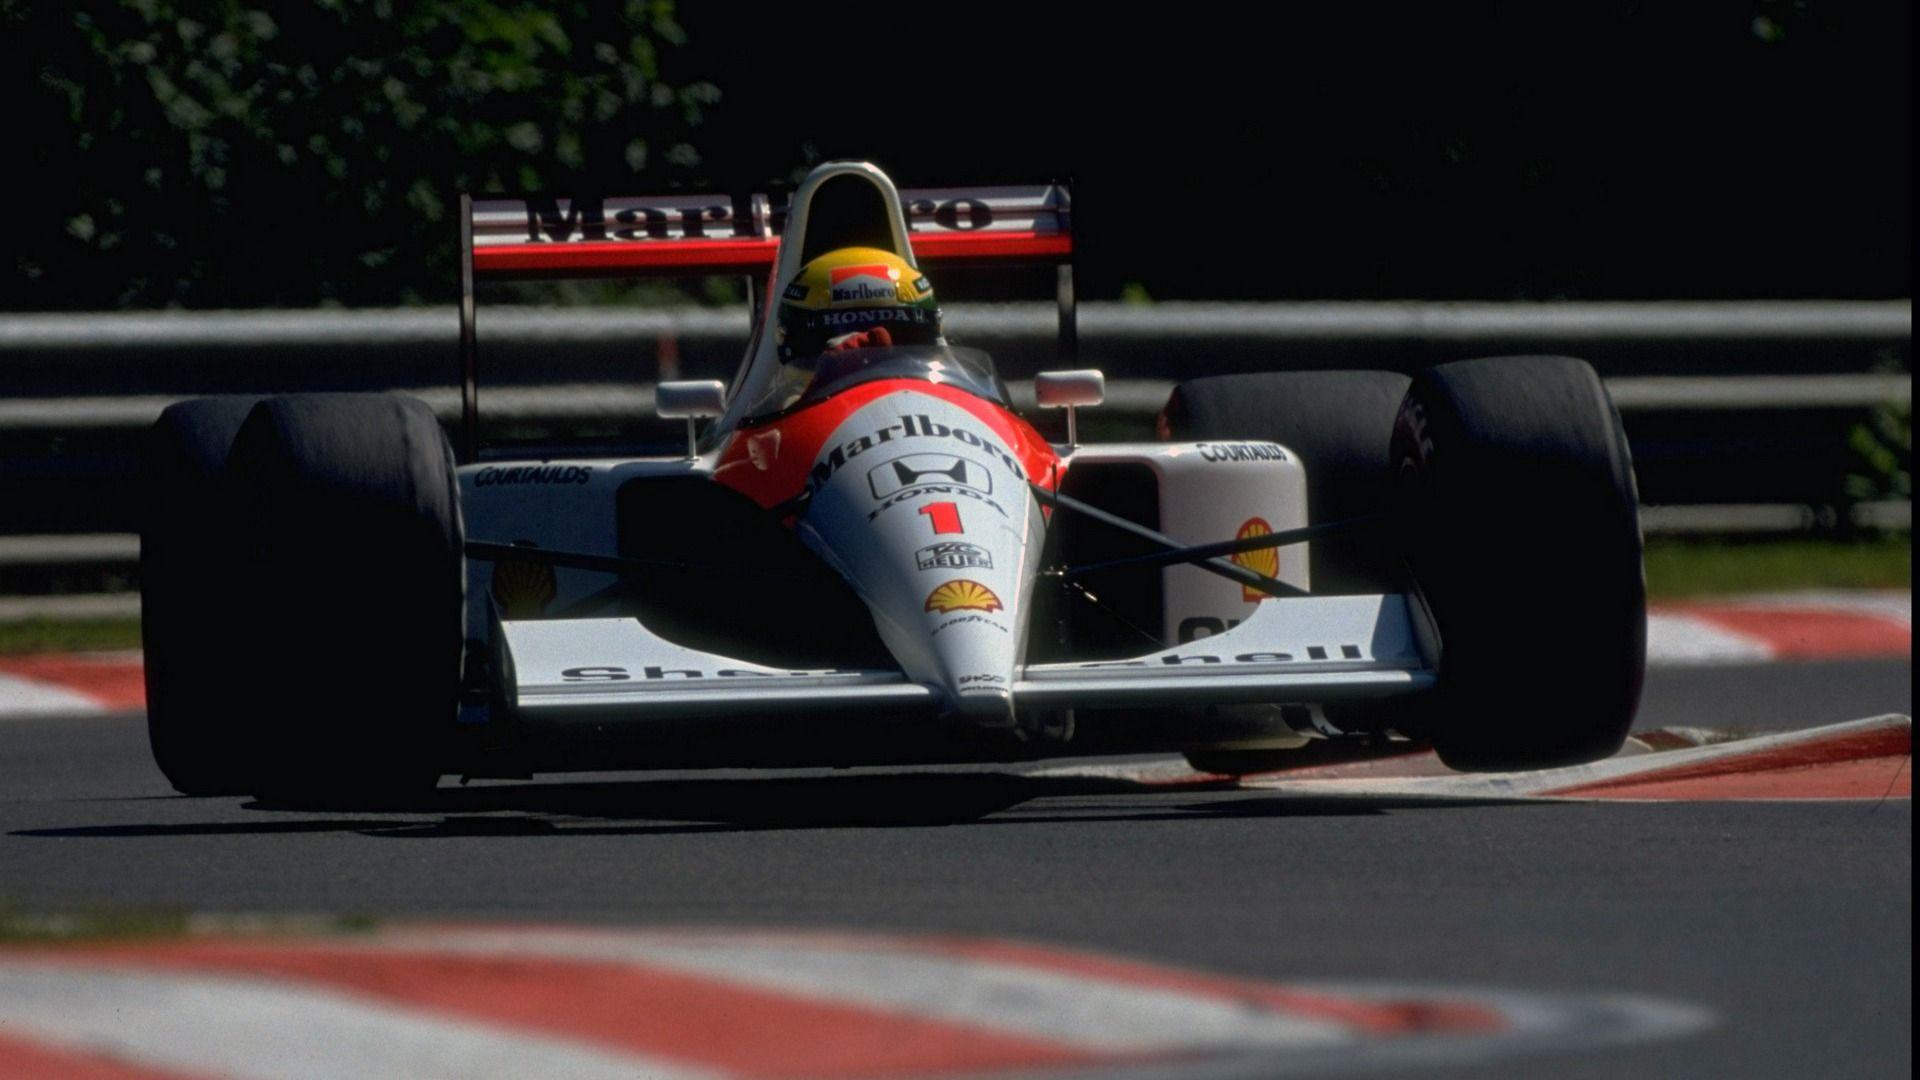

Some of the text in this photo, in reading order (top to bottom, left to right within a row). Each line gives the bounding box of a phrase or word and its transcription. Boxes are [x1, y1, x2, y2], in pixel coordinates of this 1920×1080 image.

[525, 193, 993, 242] Marlro
[832, 282, 895, 301] Marlboro
[824, 308, 911, 326] HONDA
[808, 414, 1026, 494] Marlboro
[474, 466, 593, 487] COURTAULDS
[867, 486, 1009, 523] HONDA
[918, 502, 965, 535] 1
[920, 554, 993, 569] HEUER
[1080, 645, 1363, 668] hell
